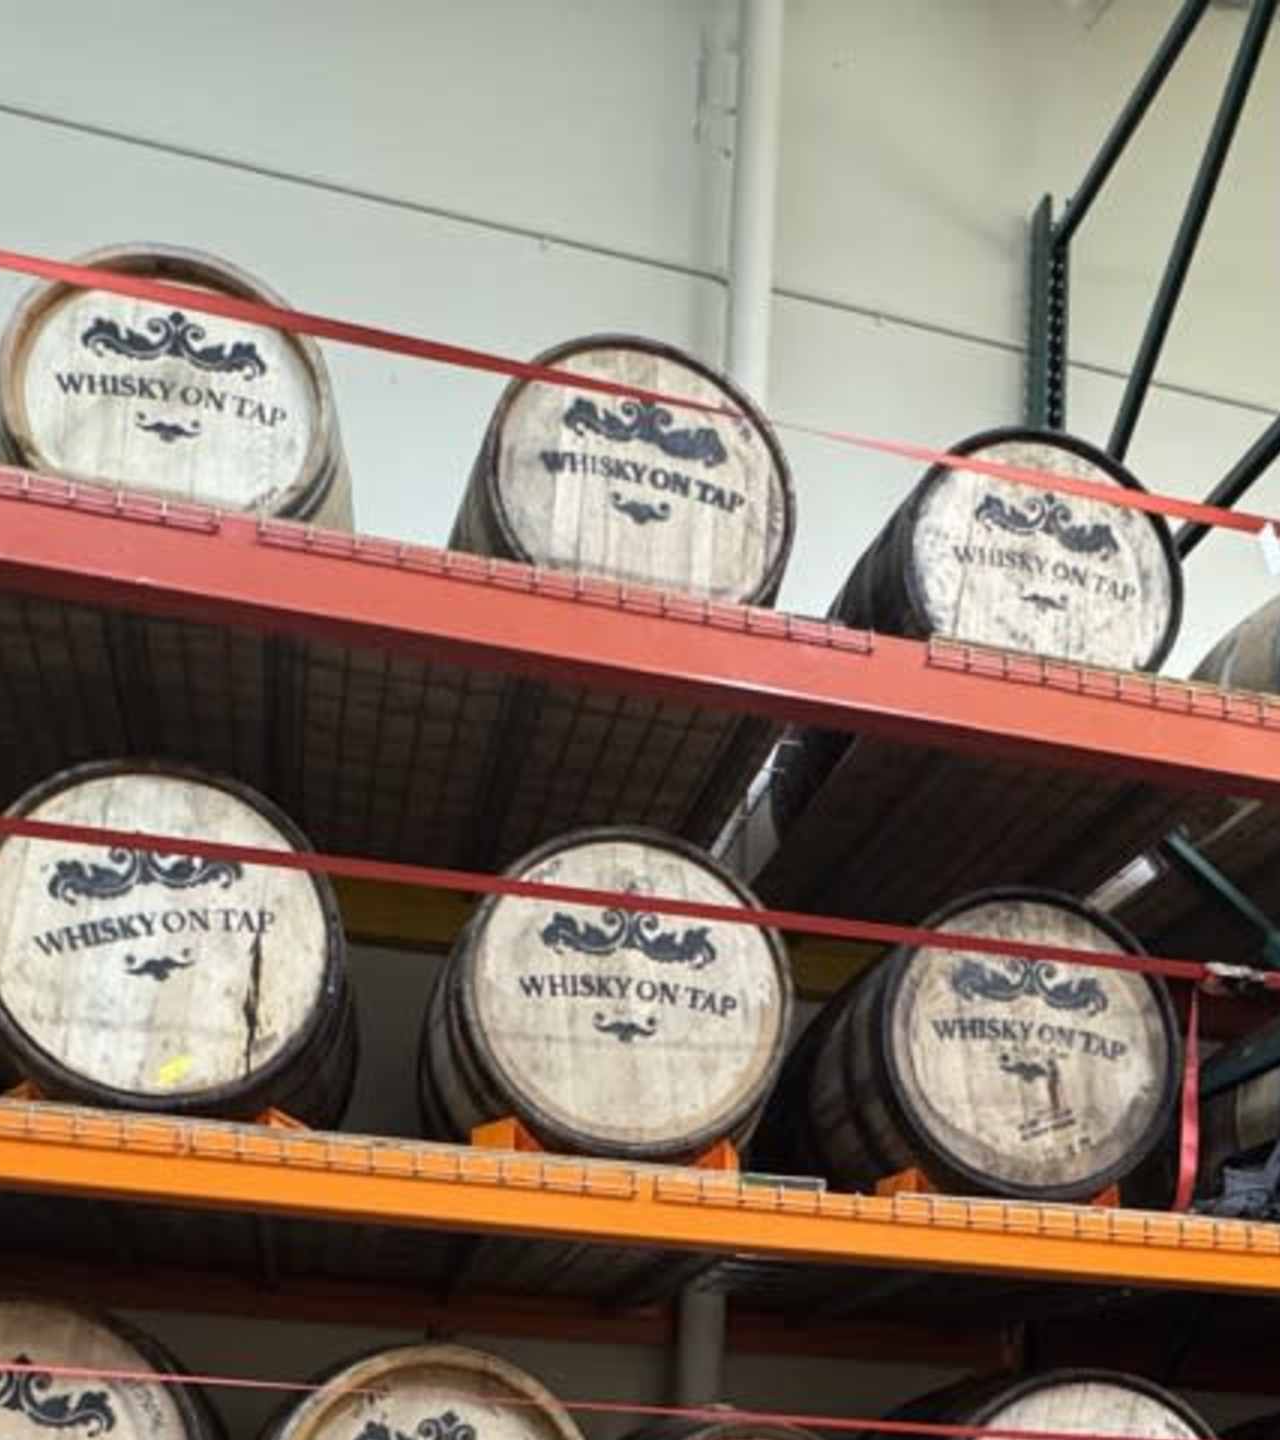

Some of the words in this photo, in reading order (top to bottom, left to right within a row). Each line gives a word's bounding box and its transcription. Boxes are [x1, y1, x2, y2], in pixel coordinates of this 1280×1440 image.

[56, 373, 177, 402] WHISKY
[180, 385, 227, 412] ON
[232, 396, 286, 428] TAP
[539, 450, 650, 486] WHISKY
[651, 464, 691, 498] ON
[694, 479, 745, 513] TAP
[953, 546, 1050, 579] WHISKY
[1052, 560, 1088, 588] ON
[1091, 567, 1136, 602] TAP
[34, 912, 157, 957] WHISKY
[161, 908, 210, 935] ON
[217, 908, 275, 935] TAP
[520, 974, 634, 1001] WHISKY
[635, 977, 682, 1006] ON
[682, 988, 738, 1018] TAP
[931, 1016, 1034, 1047] WHISKY
[1036, 1025, 1073, 1048] ON
[1077, 1030, 1127, 1061] TAP
